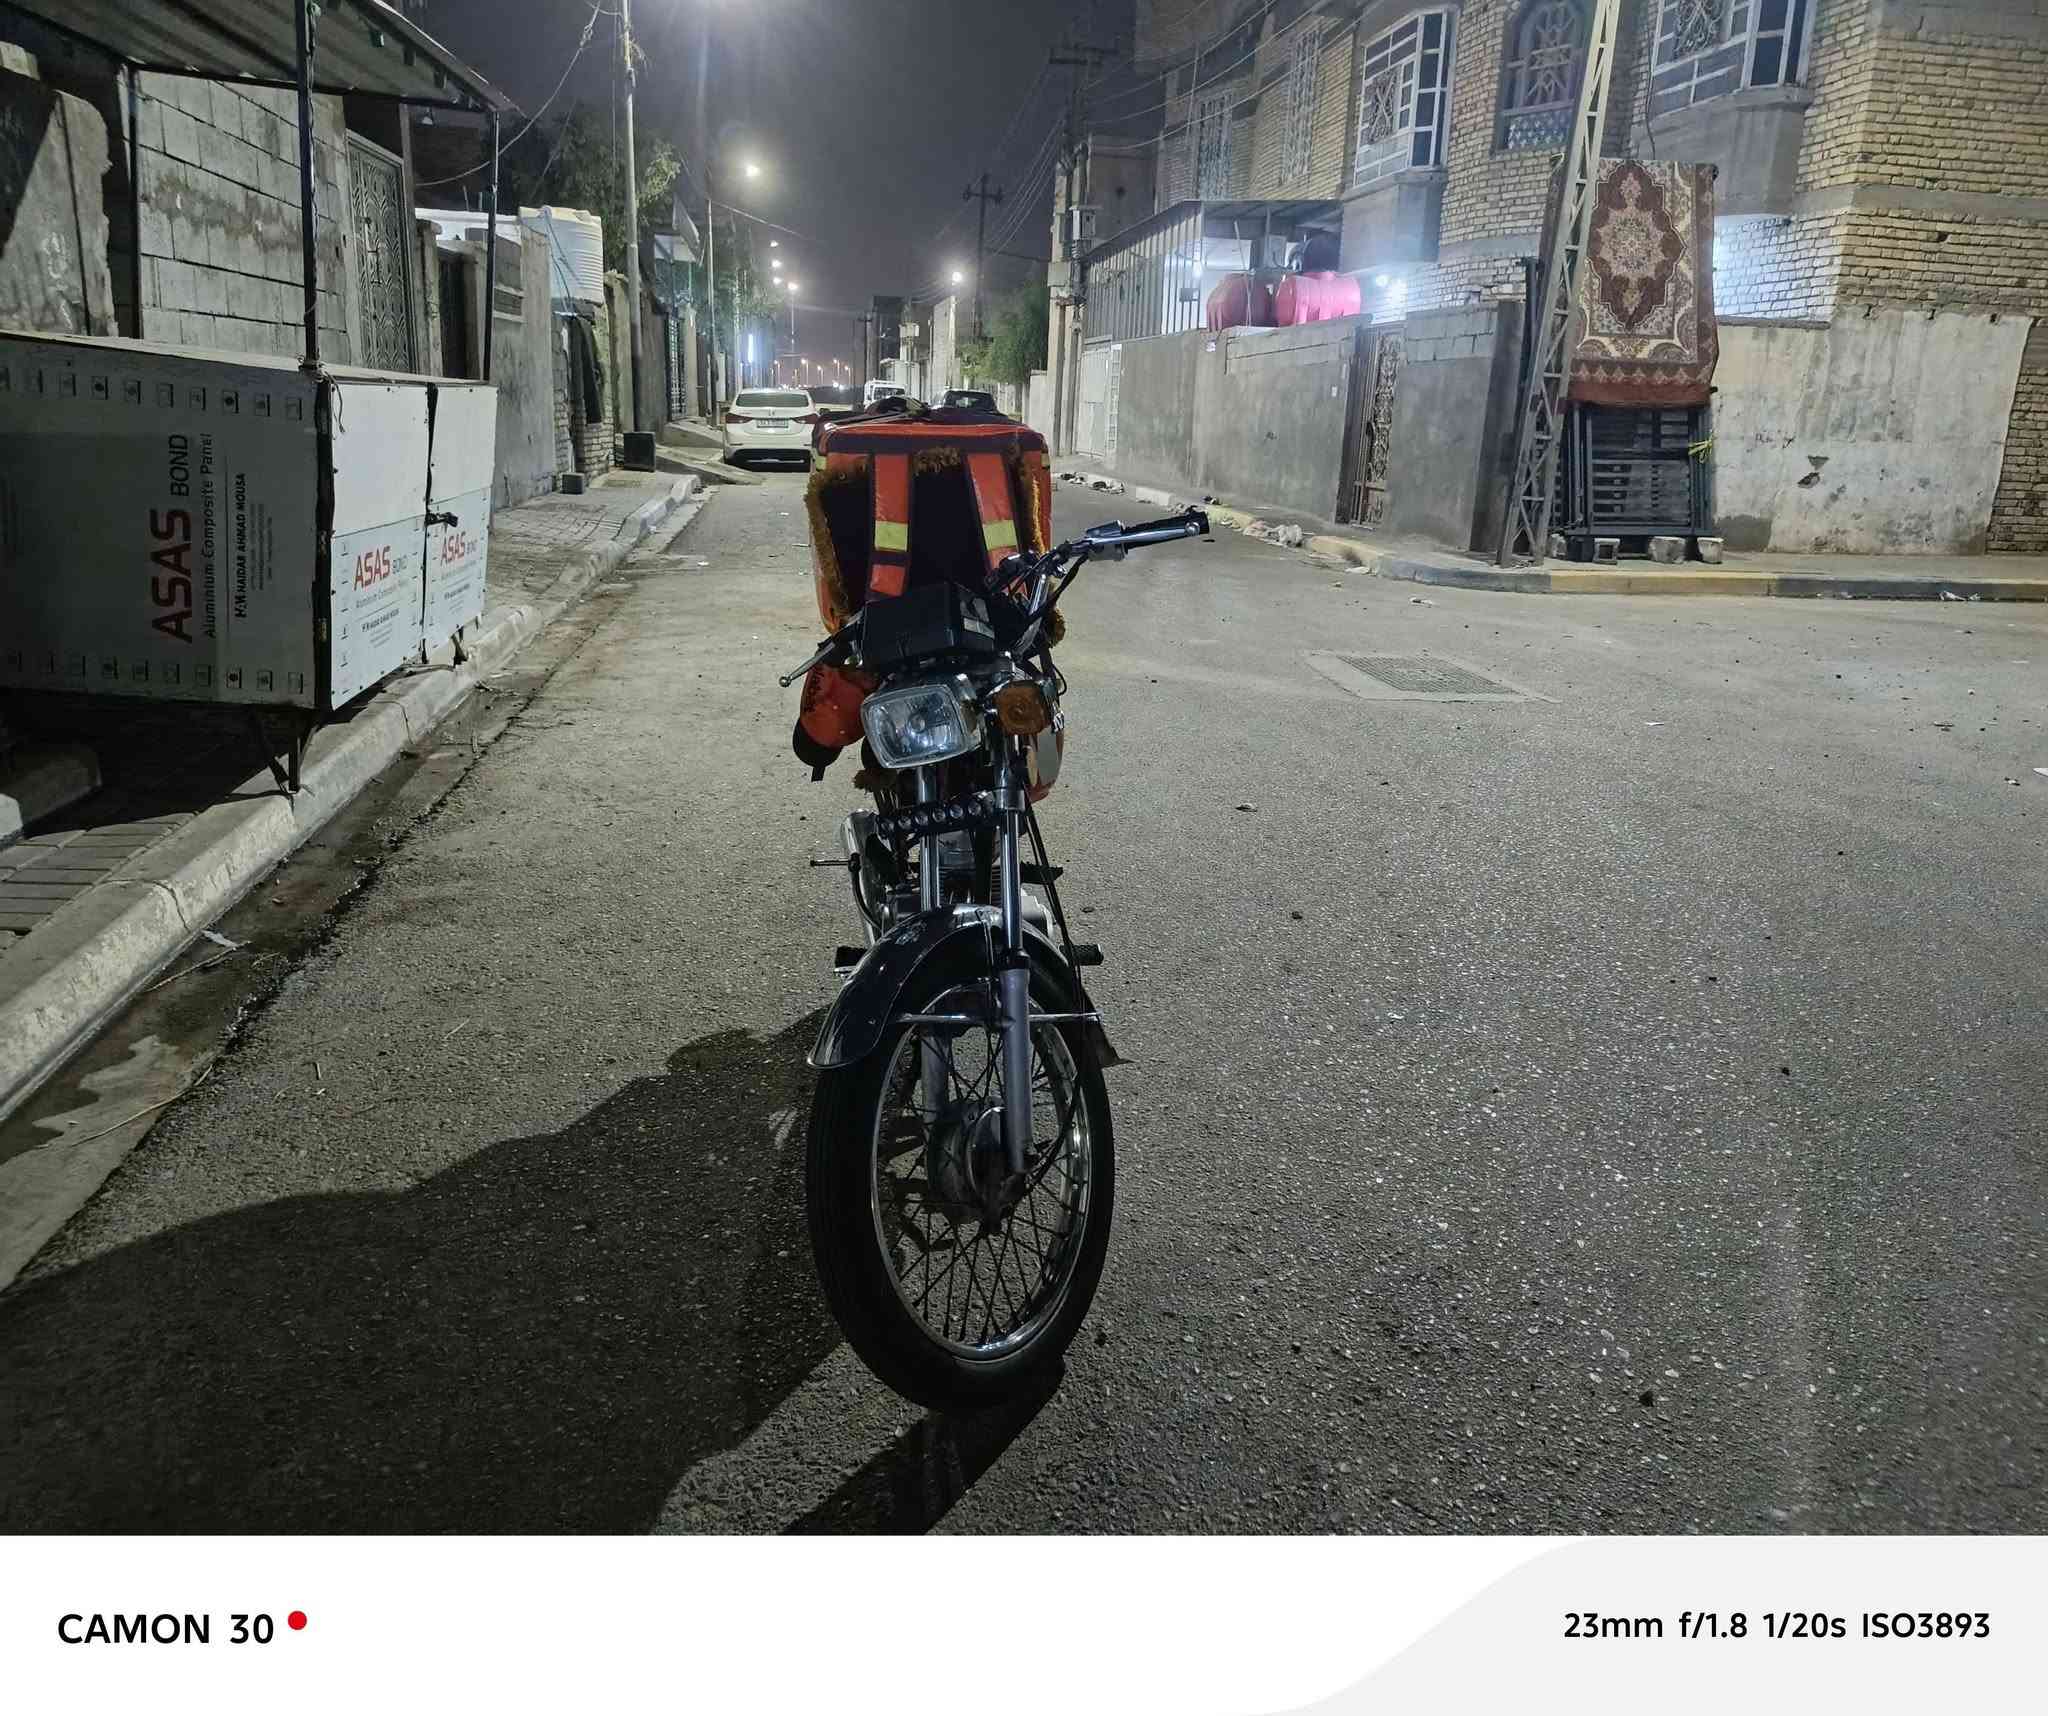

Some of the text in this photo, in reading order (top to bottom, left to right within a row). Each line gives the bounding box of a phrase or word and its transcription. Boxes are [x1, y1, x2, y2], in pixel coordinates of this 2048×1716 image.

[234, 472, 246, 511] MOUSA
[150, 433, 193, 644] ASAS BOND
[200, 432, 217, 639] Aluminium Composite Panel
[235, 514, 247, 552] AHMAD
[440, 532, 466, 567] ASAS
[353, 545, 391, 592] ASAS
